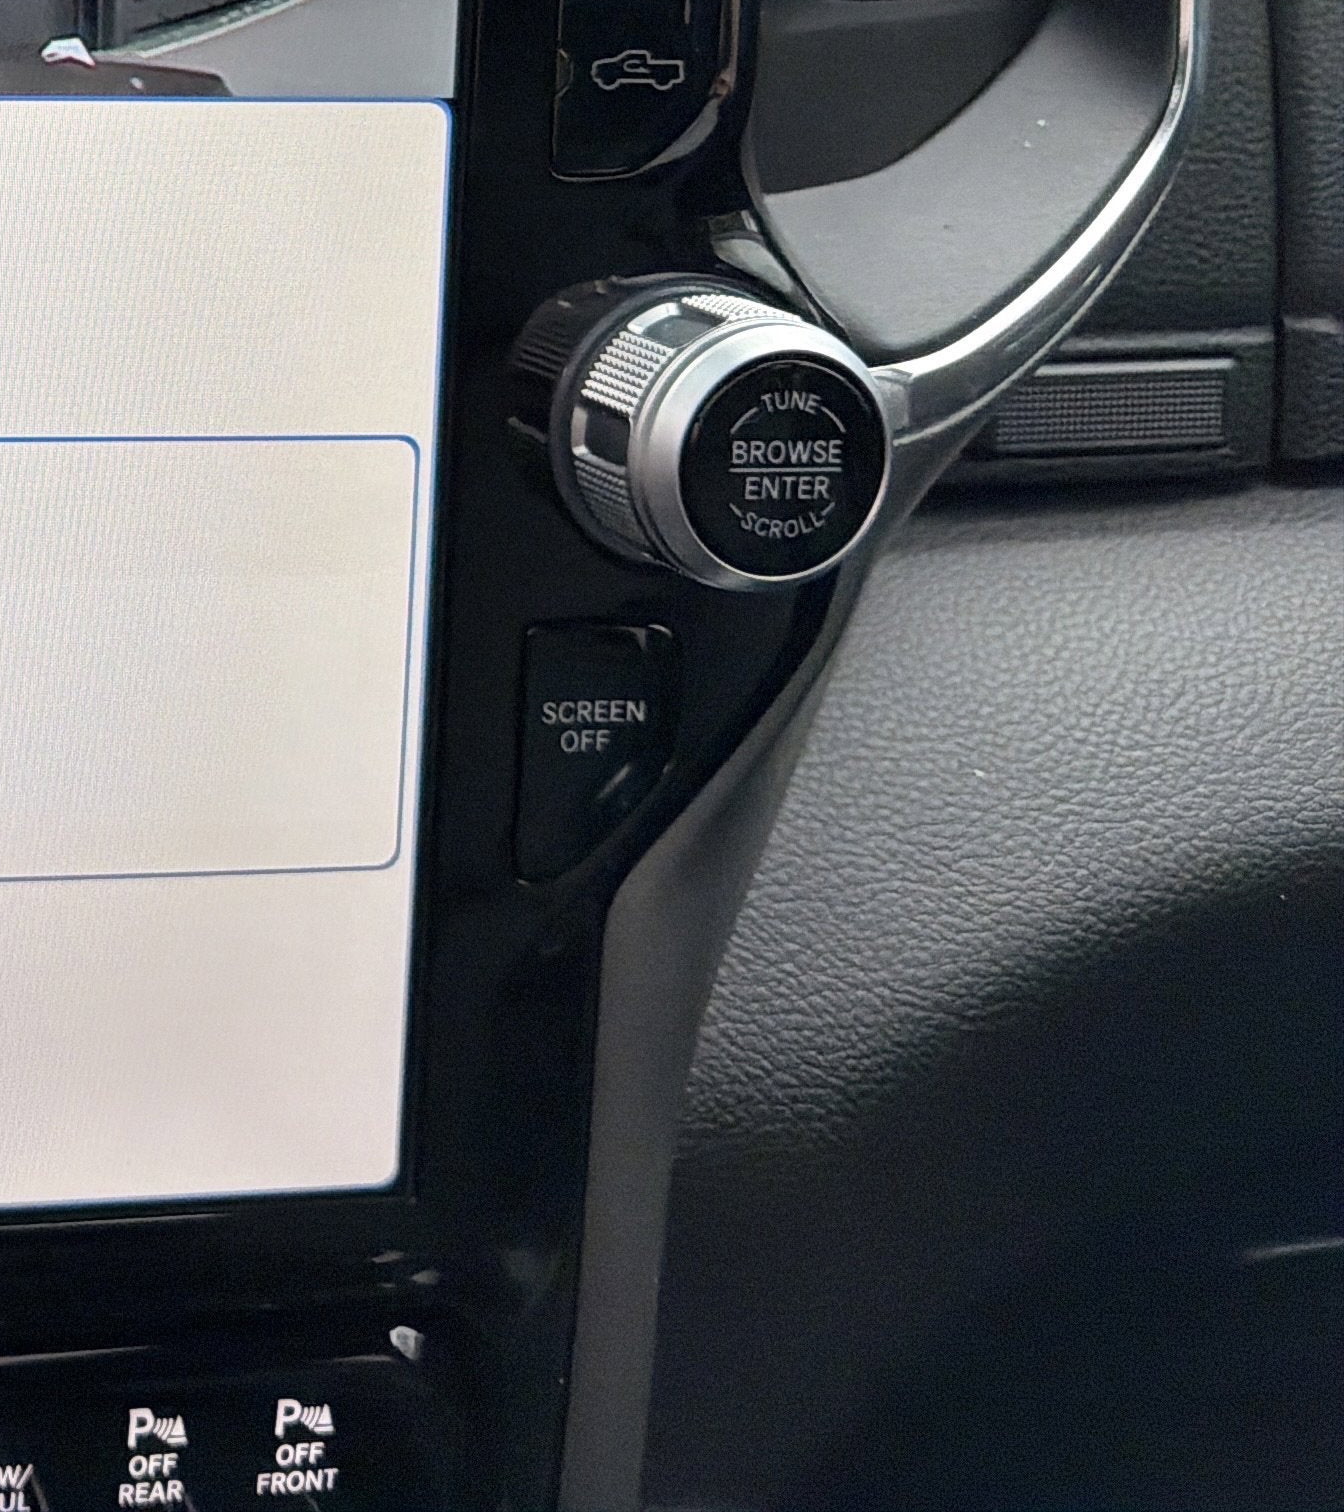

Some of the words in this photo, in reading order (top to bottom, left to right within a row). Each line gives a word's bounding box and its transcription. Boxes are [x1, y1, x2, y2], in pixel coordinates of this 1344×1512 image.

[760, 390, 821, 415] TUNE
[730, 438, 843, 464] BROWSE
[743, 474, 831, 500] ENTER
[740, 509, 826, 539] SCROLL
[542, 700, 646, 725] SCREEN
[560, 729, 610, 753] OFF
[128, 1453, 178, 1478] OFF
[275, 1442, 324, 1466] OFF
[119, 1480, 183, 1504] REAR
[256, 1468, 338, 1494] FRONT
